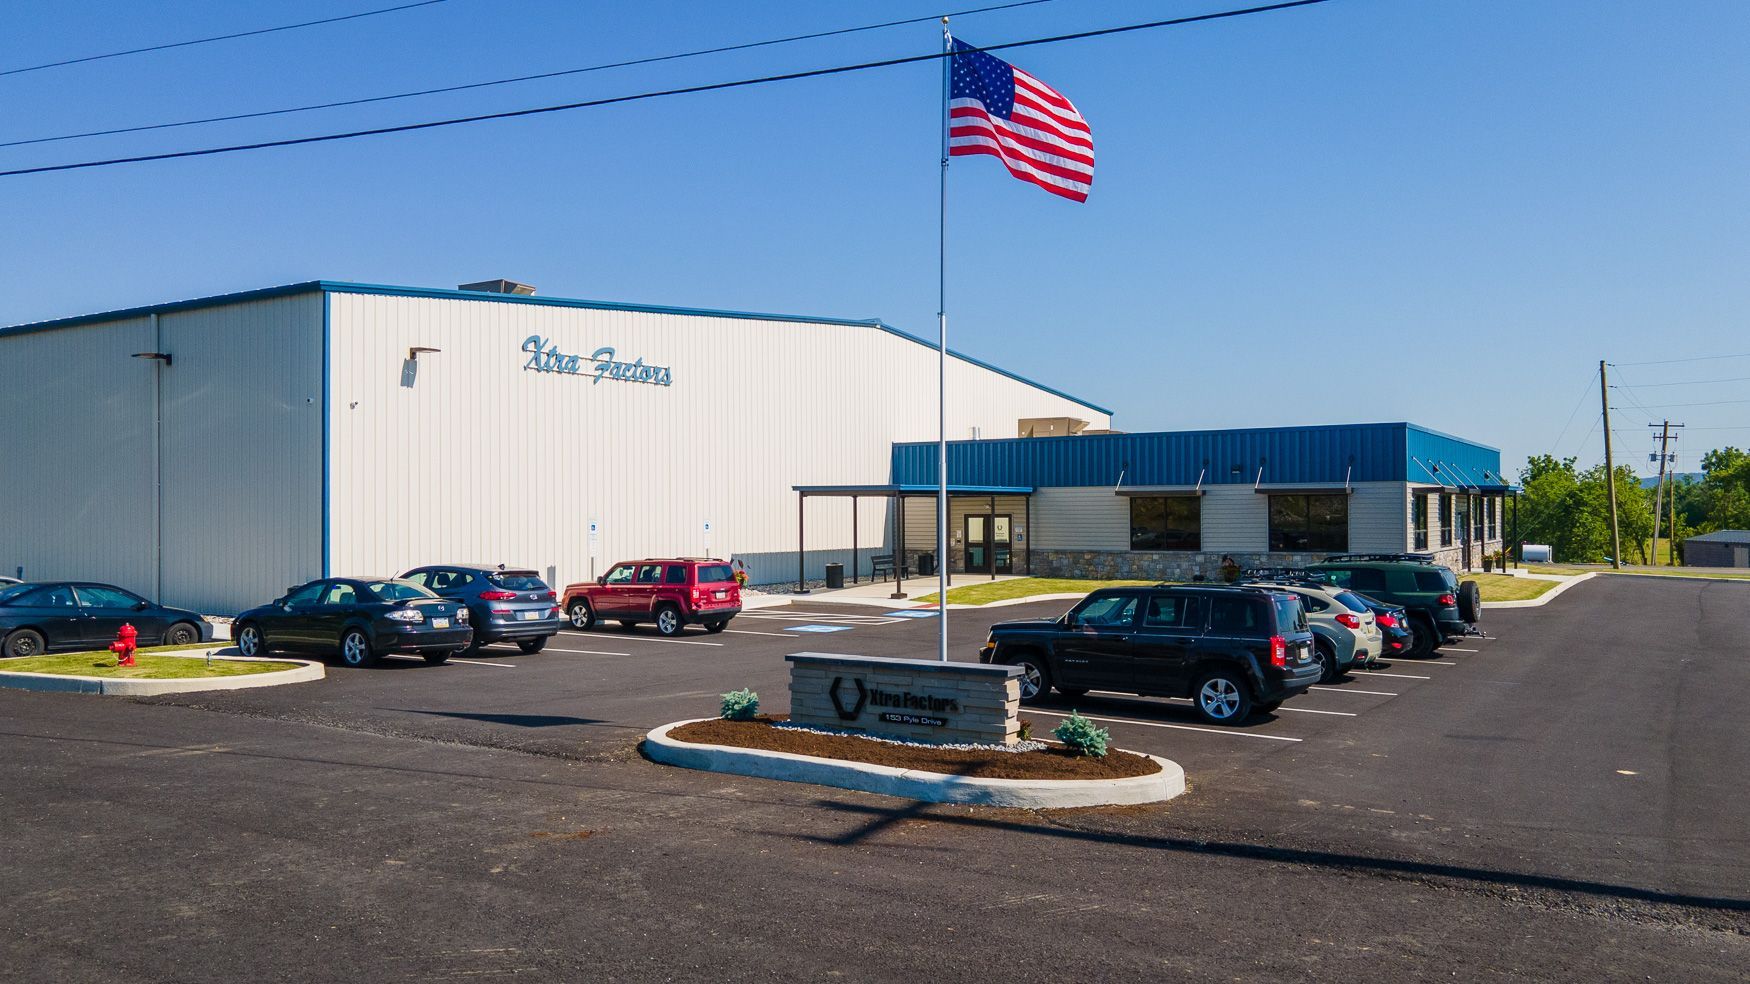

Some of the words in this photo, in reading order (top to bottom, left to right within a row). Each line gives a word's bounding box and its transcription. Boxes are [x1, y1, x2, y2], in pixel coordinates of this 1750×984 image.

[522, 335, 580, 373] Xtra
[592, 347, 672, 386] Factors
[870, 689, 900, 708] Xtra
[903, 692, 959, 711] Factors
[885, 713, 902, 722] 153
[903, 715, 920, 724] Pyle
[921, 717, 942, 726] Drive
